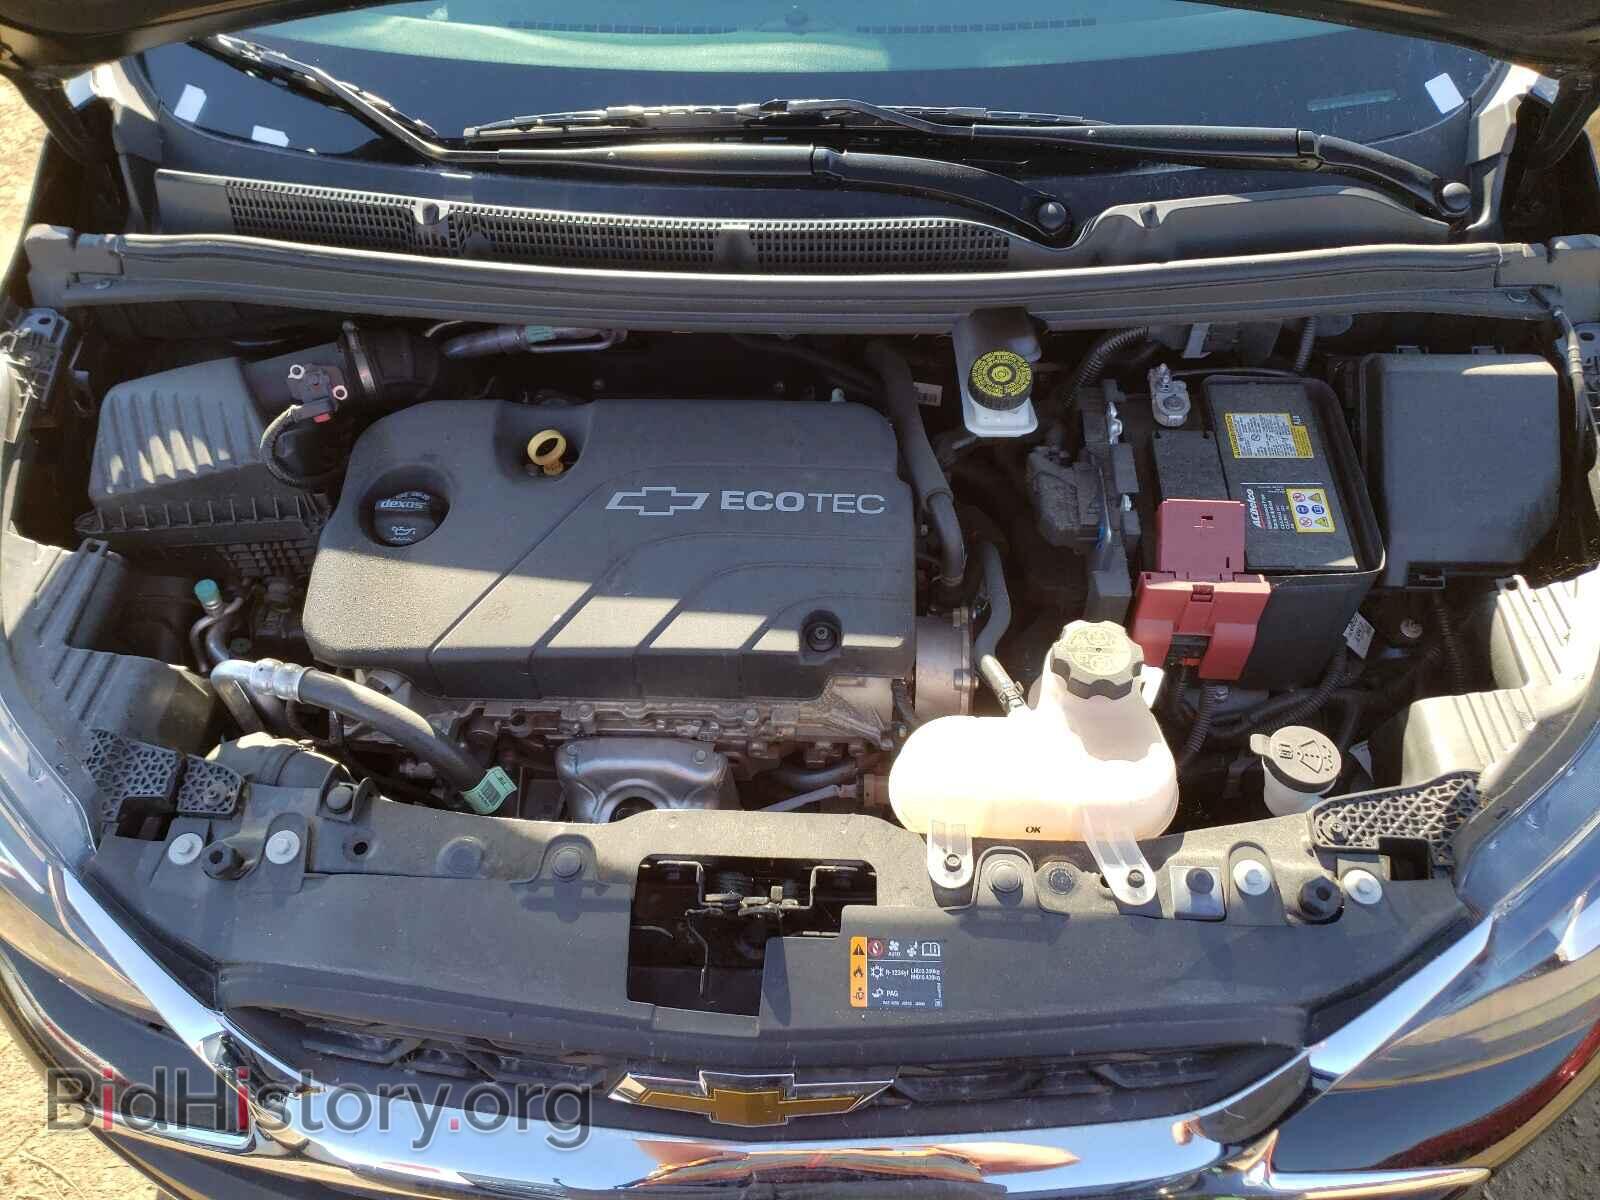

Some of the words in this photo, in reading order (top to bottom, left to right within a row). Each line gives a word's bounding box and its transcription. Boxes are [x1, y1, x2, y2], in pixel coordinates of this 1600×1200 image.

[720, 490, 886, 514] ECOTEC
[1246, 488, 1262, 528] ACDelco
[1025, 826, 1041, 834] OK
[886, 990, 899, 998] PAG
